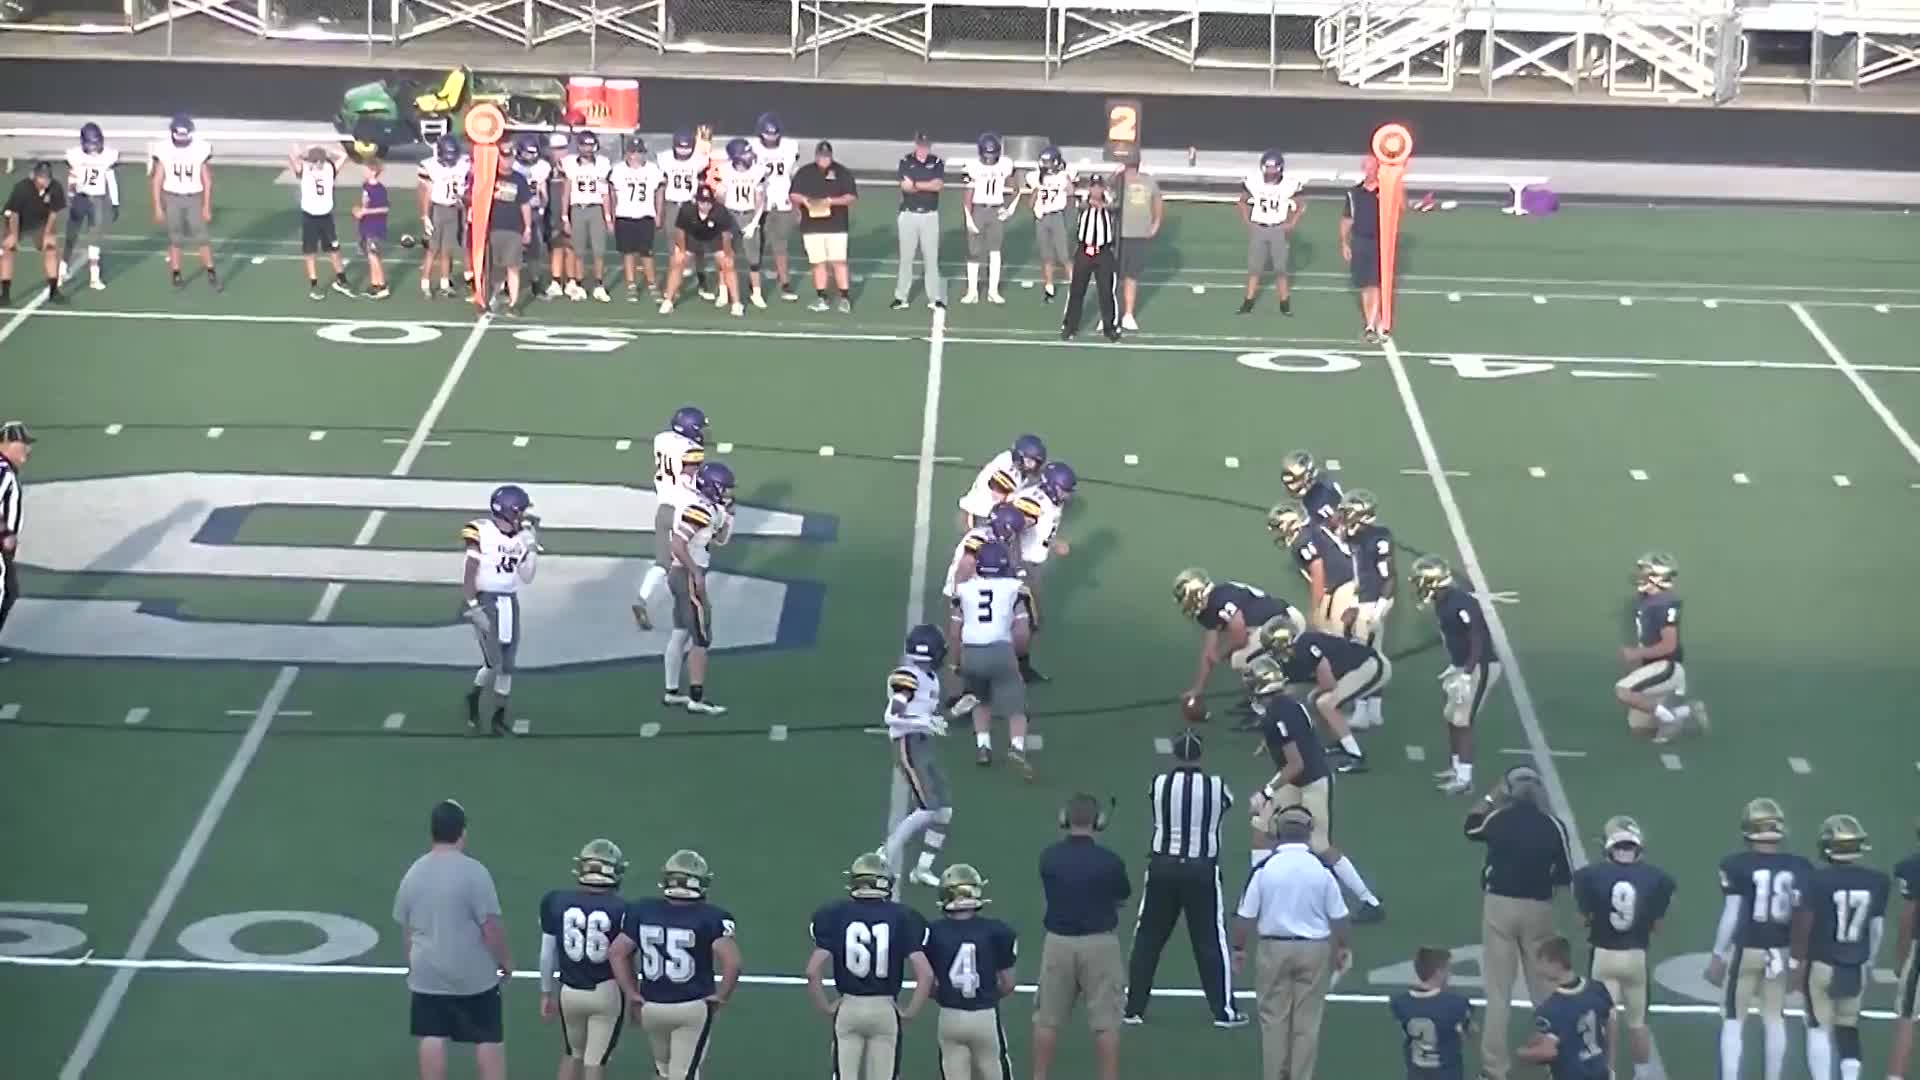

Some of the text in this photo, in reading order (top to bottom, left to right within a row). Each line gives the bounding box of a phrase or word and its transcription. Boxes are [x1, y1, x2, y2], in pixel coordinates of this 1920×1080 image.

[1108, 105, 1138, 141] 2
[173, 164, 194, 182] 44
[627, 182, 647, 202] 73
[735, 185, 751, 203] 14
[977, 589, 994, 623] 3
[1608, 880, 1637, 932] 9
[1832, 889, 1872, 943] 17
[562, 906, 612, 964] 66
[639, 924, 697, 983] 55
[845, 921, 890, 979] 61
[948, 942, 981, 998] 4
[1406, 1016, 1441, 1068] 2
